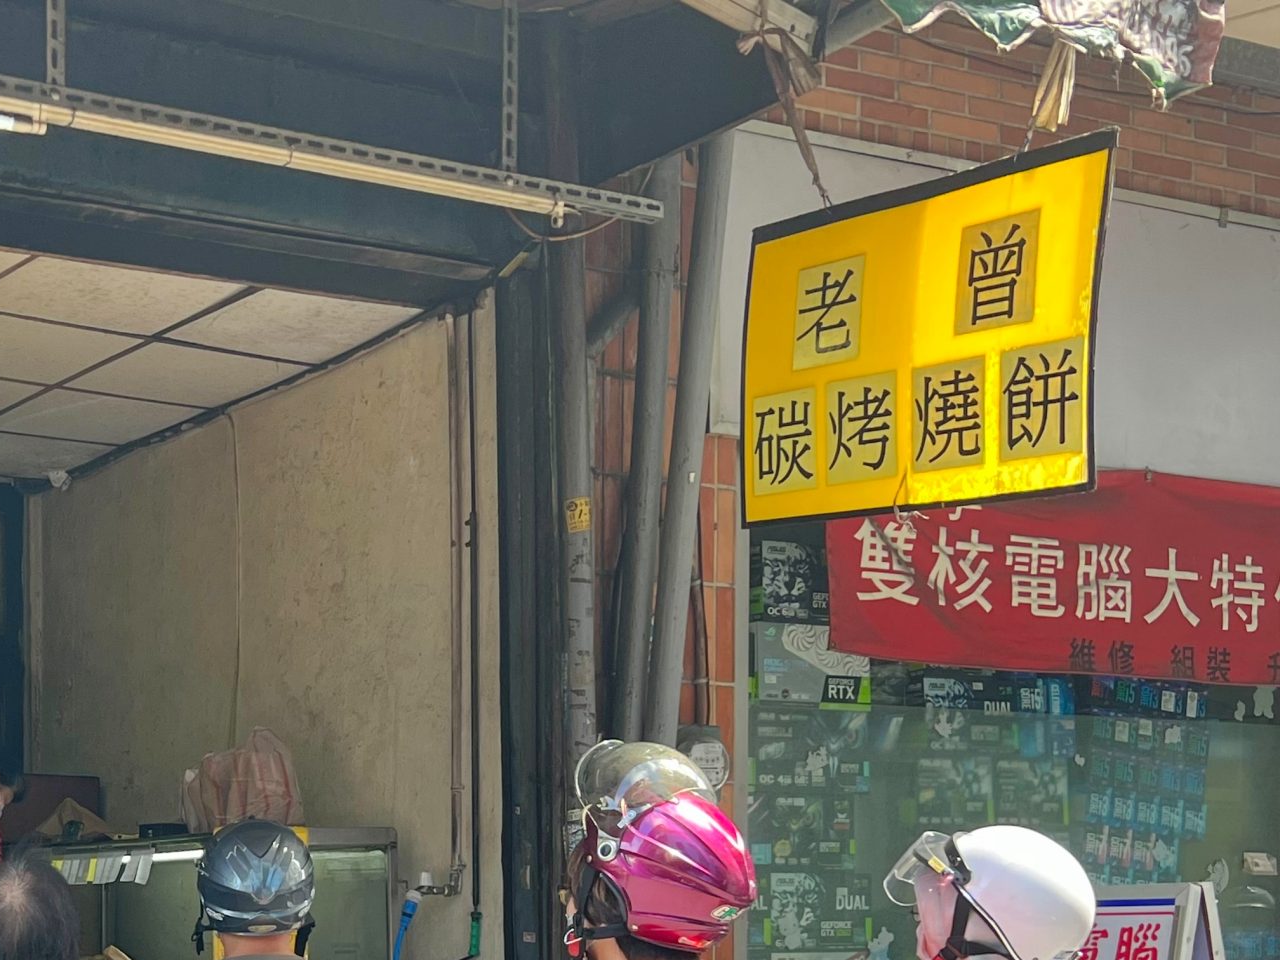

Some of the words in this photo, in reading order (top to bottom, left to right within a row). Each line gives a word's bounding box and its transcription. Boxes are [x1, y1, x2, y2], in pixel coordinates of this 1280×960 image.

[754, 348, 1079, 485] 碳烤燒餅
[854, 517, 1280, 633] 雙核電腦大特
[1069, 637, 1134, 675] 維修
[1171, 644, 1230, 683] 組裝
[828, 685, 855, 700] RTX
[835, 895, 869, 910] DUAL
